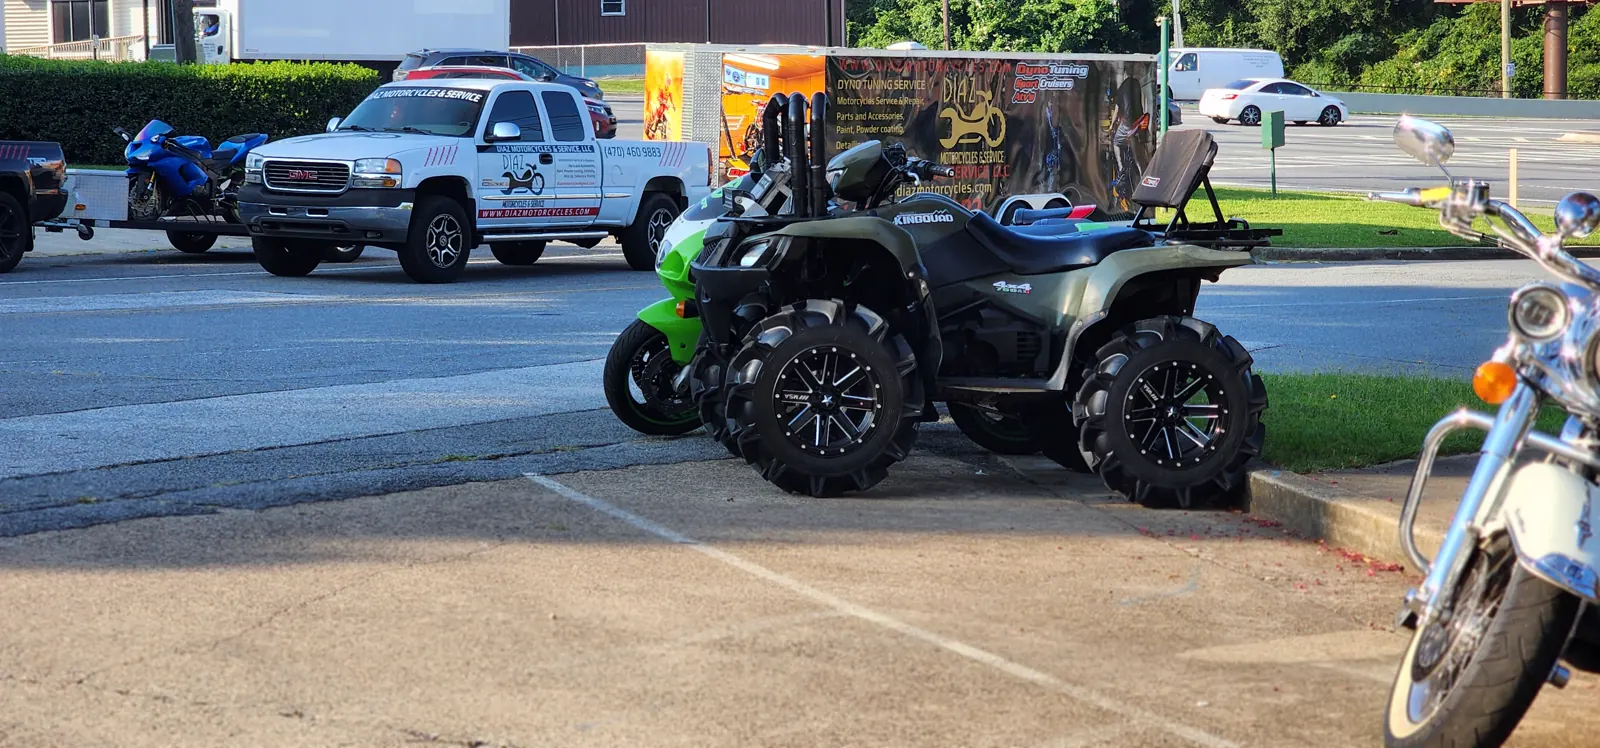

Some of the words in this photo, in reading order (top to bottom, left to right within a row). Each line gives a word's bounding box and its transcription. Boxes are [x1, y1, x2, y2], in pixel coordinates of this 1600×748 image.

[837, 79, 861, 90] DYNO
[863, 79, 893, 90] TUNING
[894, 80, 926, 90] SERVICE
[943, 75, 976, 103] DIAZ
[1015, 78, 1039, 88] Sport
[1040, 79, 1073, 88] Cruisers
[383, 88, 438, 99] MOTORCYCLES
[438, 89, 446, 98] &
[445, 90, 483, 103] SERVICE
[836, 96, 875, 107] Motorcycles
[875, 96, 898, 105] Service
[836, 112, 854, 121] Parts
[855, 112, 867, 121] and
[856, 125, 879, 134] Powder
[496, 145, 511, 153] DIAZ
[511, 145, 552, 153] MOTORCYCLES
[604, 146, 625, 158] (470)
[626, 147, 641, 157] 460
[642, 147, 661, 158] 9883
[502, 154, 524, 170] DIAZ
[940, 151, 978, 165] MOTORCYCLES
[983, 150, 1005, 164] SERVICE
[288, 169, 318, 181] GMC
[952, 165, 989, 179] ERVICE
[482, 208, 590, 218] WWW.DIAZMOTORCYCLES.COM
[892, 213, 954, 226] KINGQUAD
